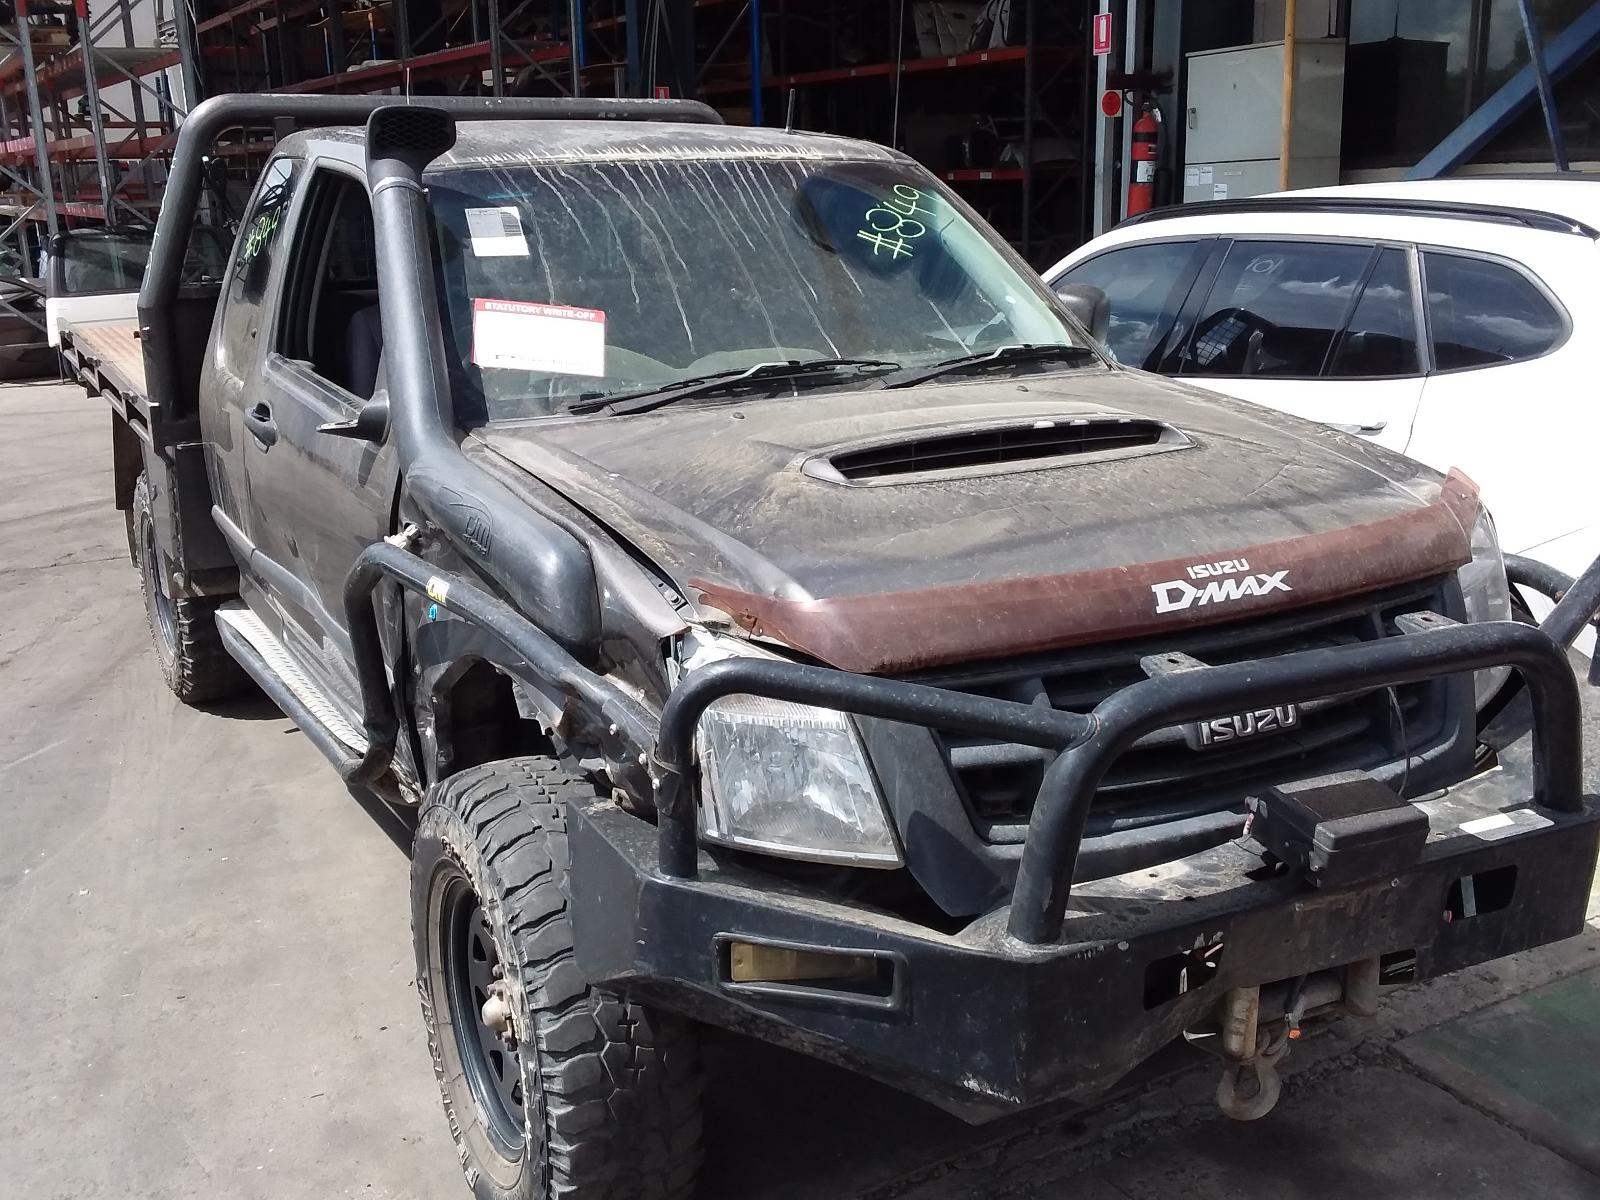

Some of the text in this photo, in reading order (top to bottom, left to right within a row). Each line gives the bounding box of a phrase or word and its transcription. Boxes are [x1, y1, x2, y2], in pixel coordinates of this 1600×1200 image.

[244, 205, 281, 263] #849
[857, 185, 941, 260] #849
[484, 302, 596, 321] STATUTORY WRITE-OFF
[1186, 558, 1250, 579] ISUZU
[1151, 570, 1293, 614] D-MAX
[1201, 704, 1297, 744] ISUZU
